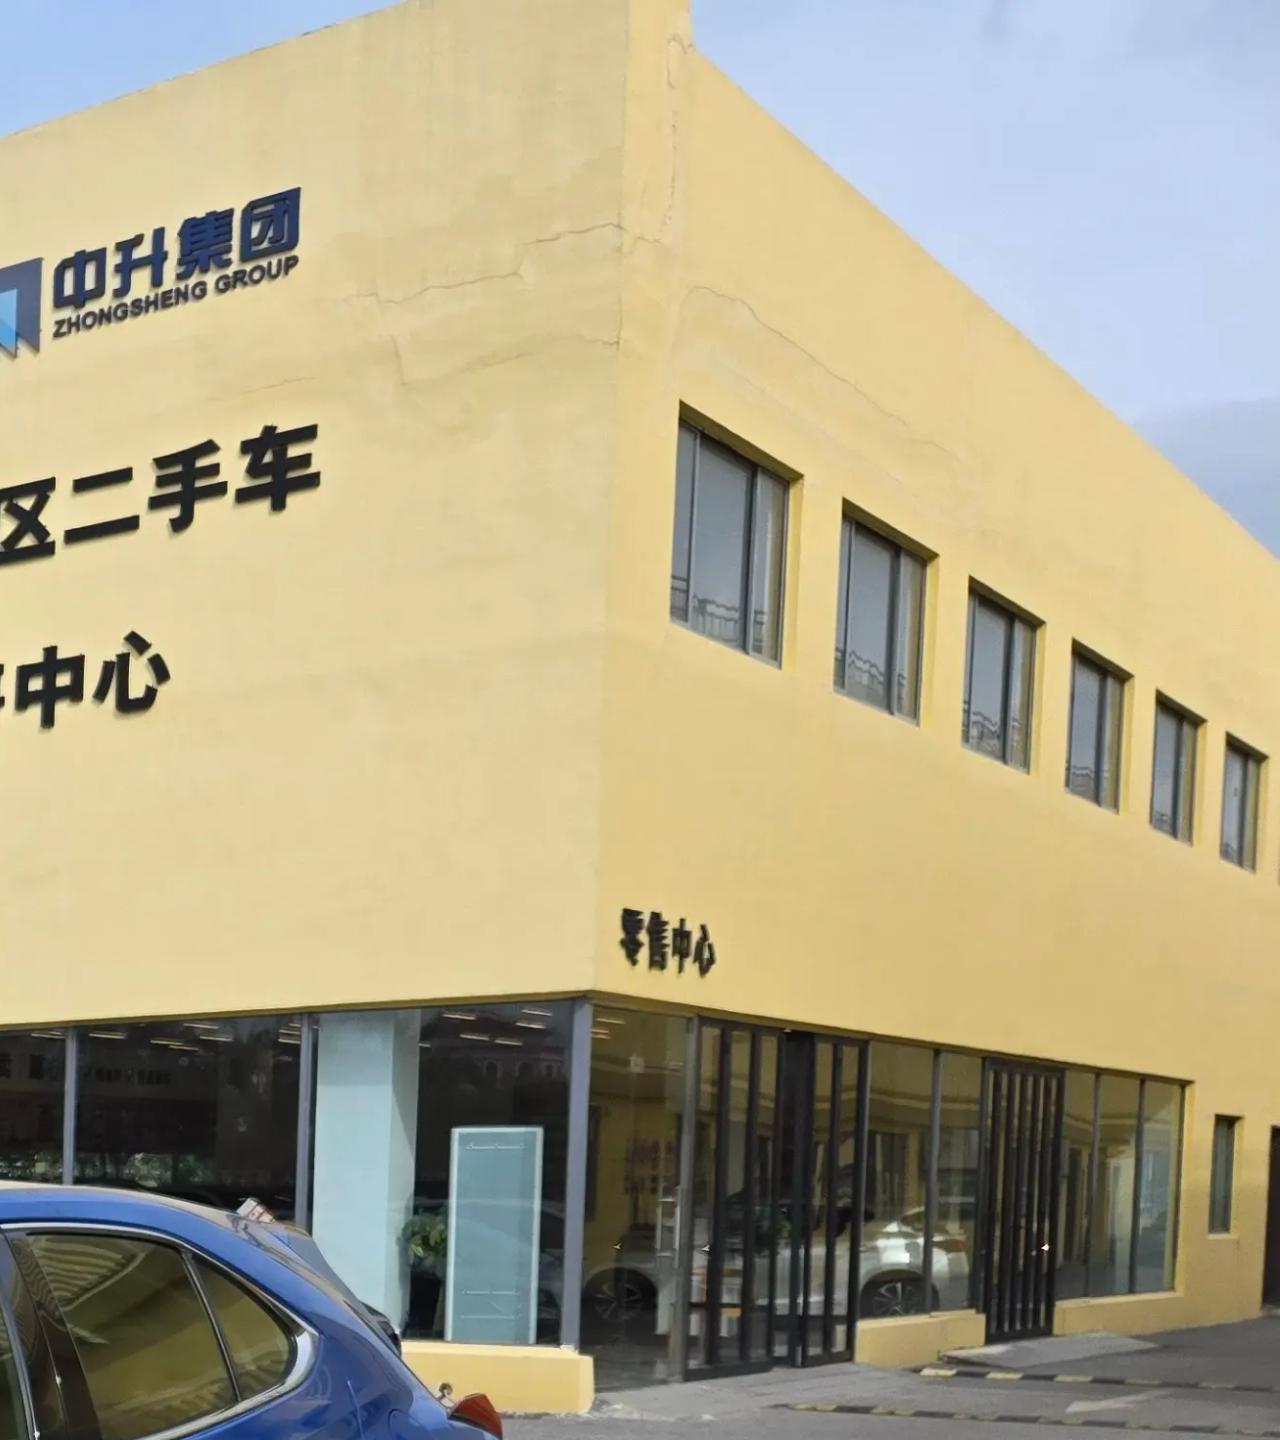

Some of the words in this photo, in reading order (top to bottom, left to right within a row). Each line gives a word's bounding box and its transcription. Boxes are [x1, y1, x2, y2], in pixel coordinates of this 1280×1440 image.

[53, 187, 301, 310] 中升集团
[52, 280, 208, 339] ZHONGSHENG
[214, 254, 300, 294] GROUP
[618, 907, 717, 977] 零售中心
